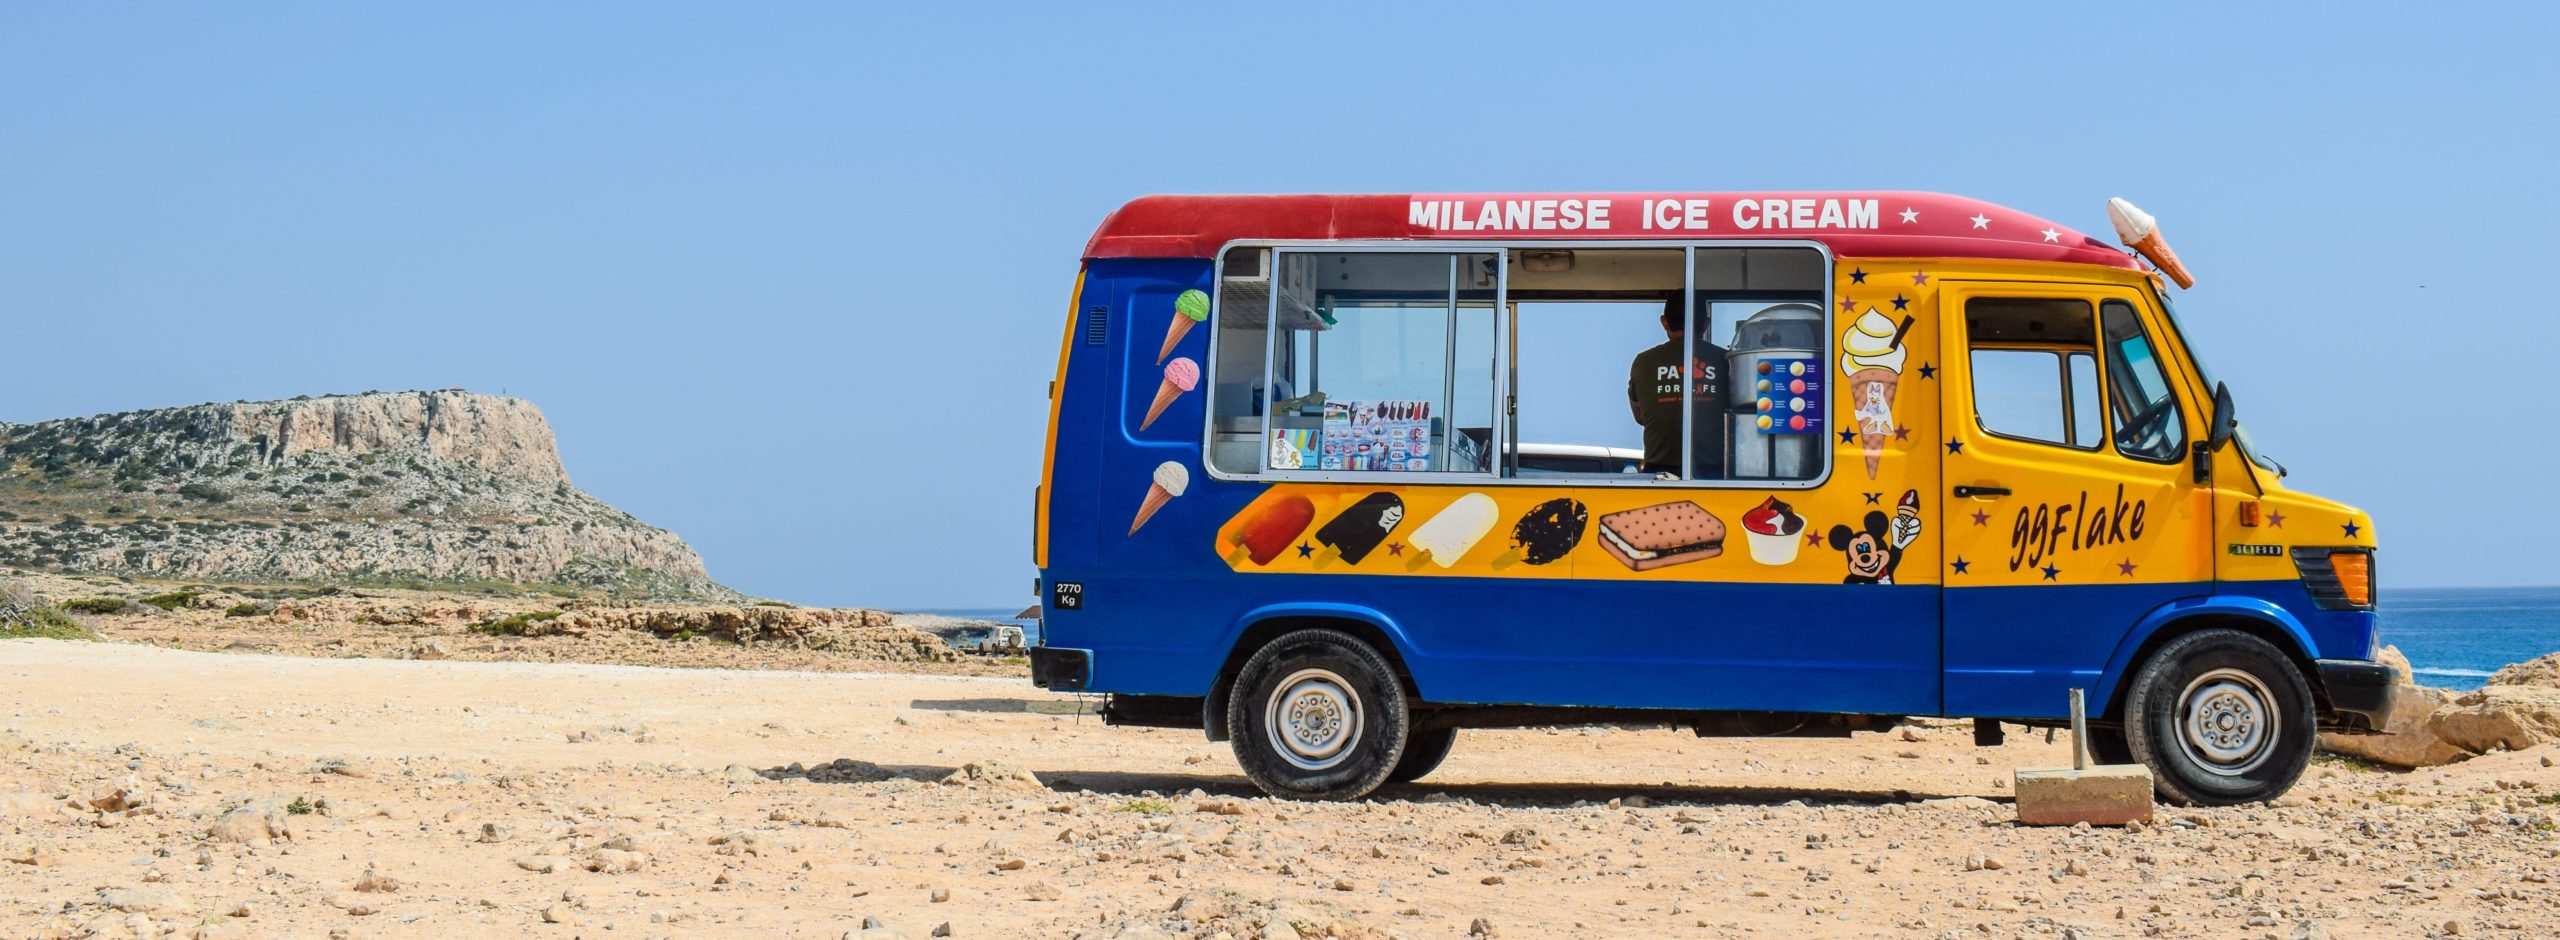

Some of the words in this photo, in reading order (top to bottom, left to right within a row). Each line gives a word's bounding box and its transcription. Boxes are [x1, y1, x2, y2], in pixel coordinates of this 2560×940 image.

[1409, 199, 1611, 231] MILANESE
[1642, 199, 1709, 230] ICE
[1733, 199, 1879, 230] CREAM
[1657, 364, 1716, 380] PAS
[1657, 384, 1681, 393] FOR
[1057, 583, 1081, 593] 2770
[1062, 595, 1075, 606] Kg
